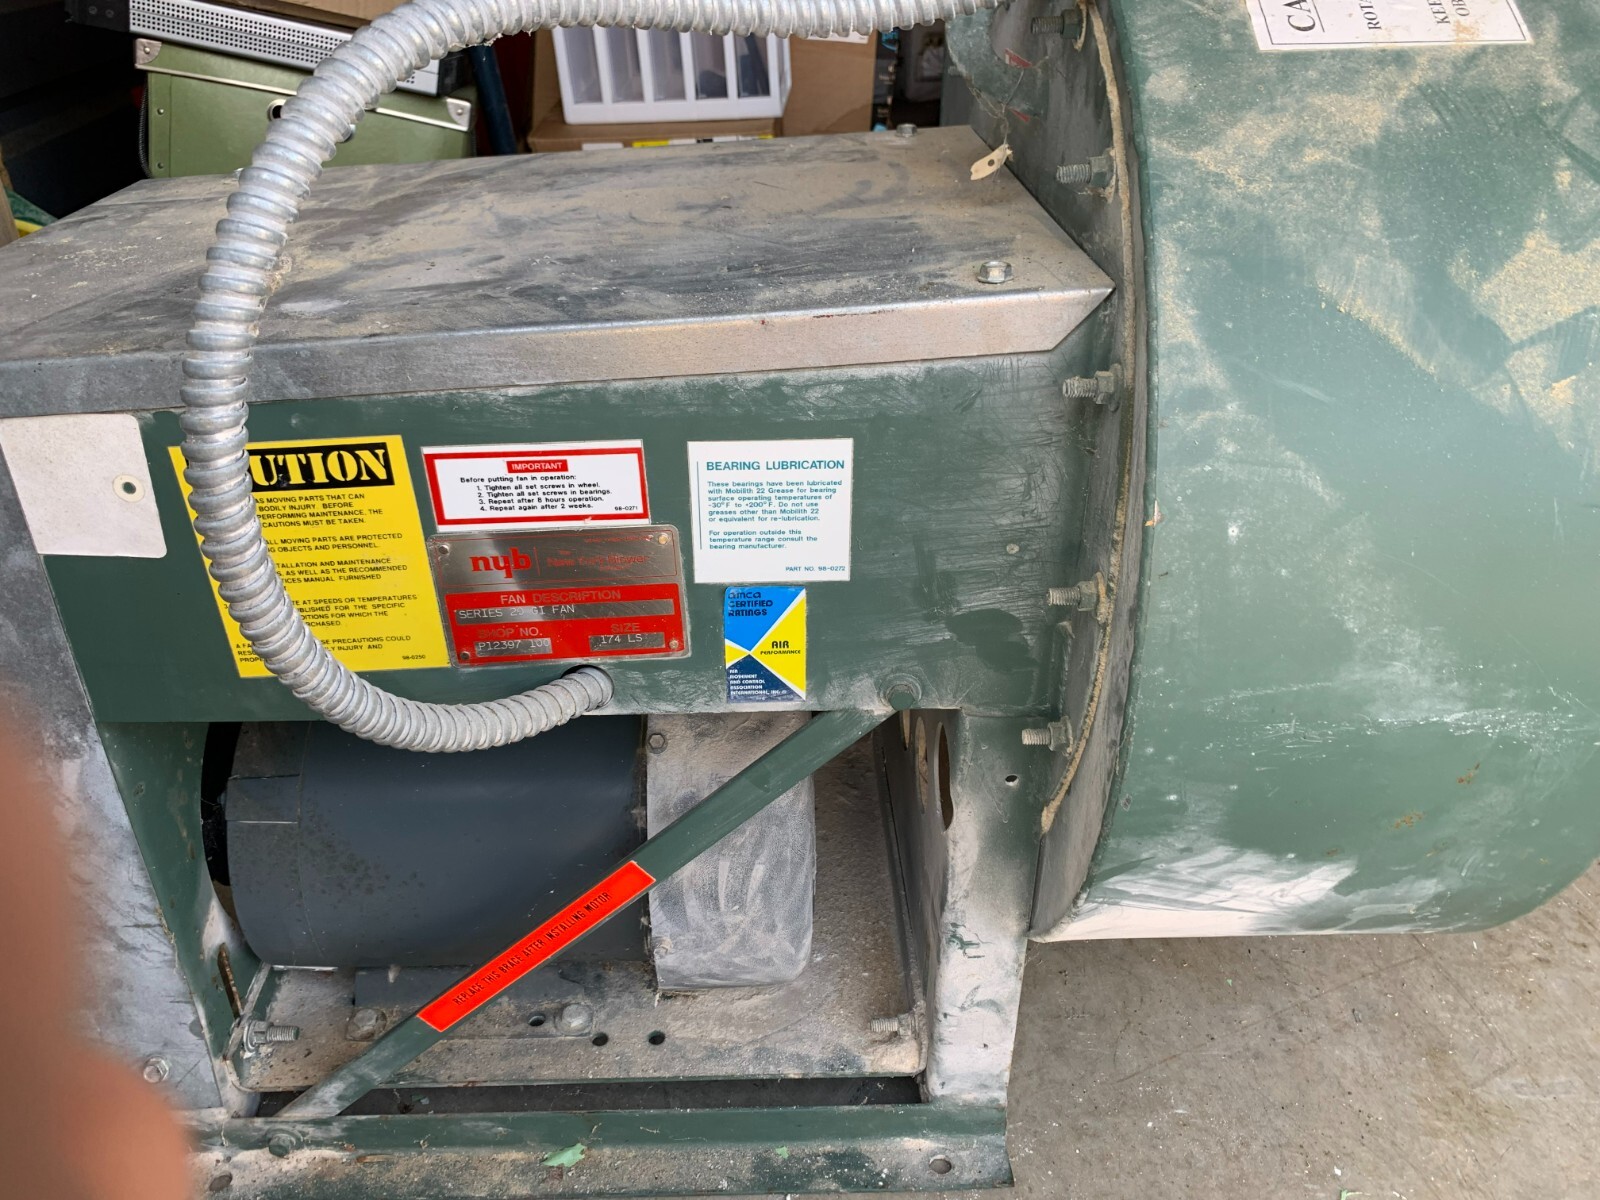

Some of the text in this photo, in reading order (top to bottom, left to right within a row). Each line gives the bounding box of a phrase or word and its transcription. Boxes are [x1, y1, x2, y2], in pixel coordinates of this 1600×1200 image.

[249, 449, 387, 486] UTION
[511, 462, 562, 470] IMPORTANT
[706, 460, 845, 471] BEARING LUBRICATION
[484, 484, 512, 492] Tighten
[809, 486, 837, 494] bearing
[266, 496, 297, 504] MOVING
[298, 494, 325, 502] PARTS
[486, 491, 514, 499] Tighten
[707, 495, 735, 503] surface
[737, 494, 772, 502] operating
[322, 501, 354, 510] BEFORE
[325, 518, 337, 526] BE
[280, 537, 311, 545] MOVING
[311, 535, 338, 543] PARTS
[356, 532, 403, 541] PROTECTED
[277, 545, 313, 553] OBJECTS
[276, 561, 318, 569] TALLATION
[336, 558, 391, 566] MAINTENANCE
[469, 547, 532, 579] nyb
[348, 564, 408, 573] RECOMMENDED
[338, 573, 382, 581] FURNISHED
[313, 597, 343, 605] SPEEDS
[357, 594, 417, 603] TEMPERATURES
[728, 599, 773, 608] CERTIFIED
[371, 602, 405, 610] SPECIFIC
[728, 608, 767, 617] RATINGS
[332, 636, 384, 644] PRECAUTIONS
[453, 892, 610, 1005] REPLACE THIS BRACE AFTER INSTALLING MOTOR
